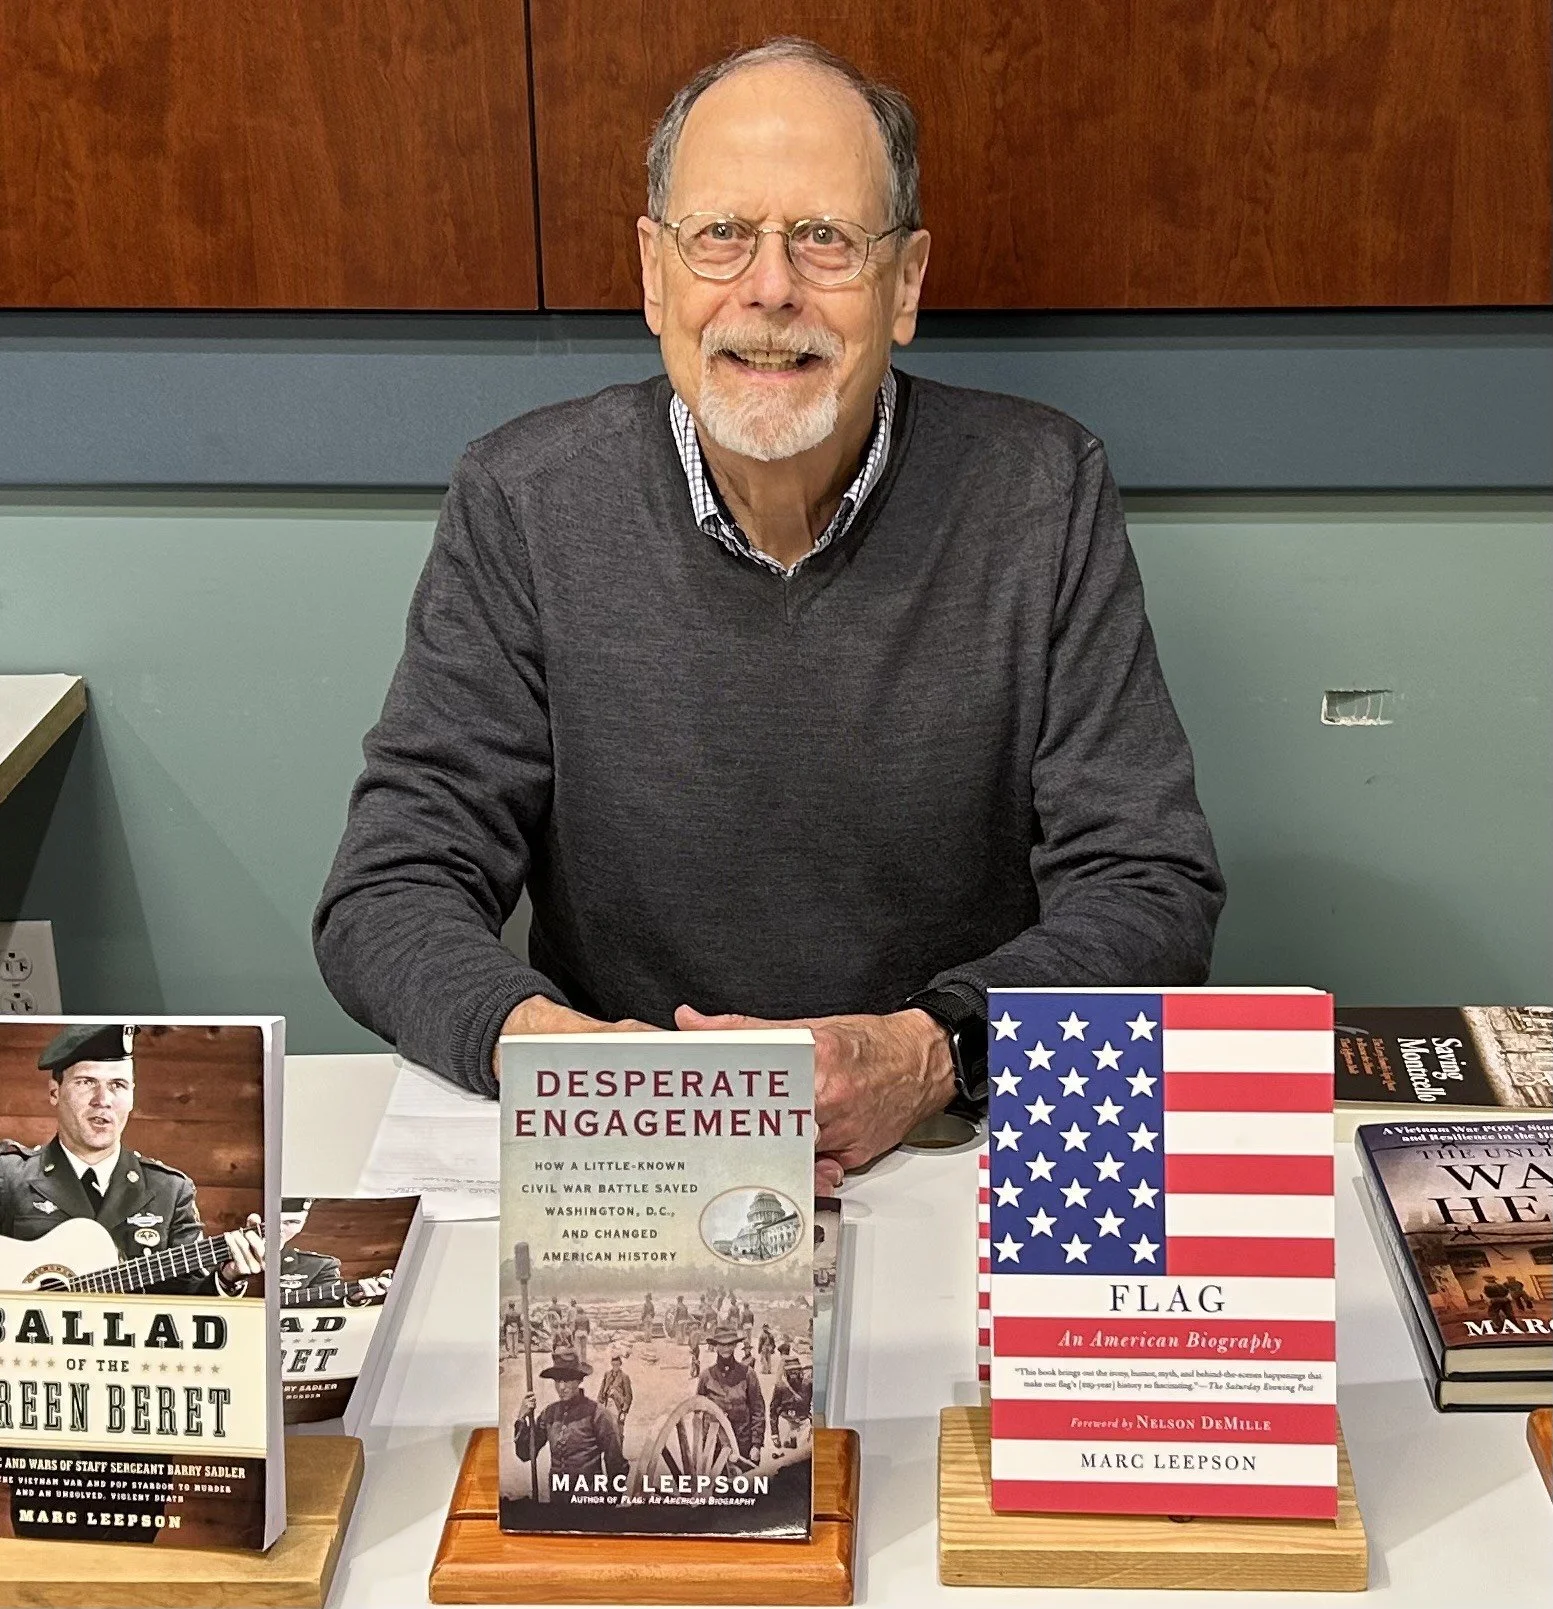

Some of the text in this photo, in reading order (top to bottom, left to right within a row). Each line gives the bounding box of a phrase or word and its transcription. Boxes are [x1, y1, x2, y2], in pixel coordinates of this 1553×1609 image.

[1431, 1037, 1466, 1081] Saving
[1397, 1037, 1447, 1102] Monticello
[536, 1070, 790, 1097] DESPERATE
[515, 1109, 812, 1137] ENGAGEMENT
[1383, 1127, 1393, 1136] A
[1393, 1125, 1450, 1134] Vietnam
[1452, 1125, 1480, 1133] War
[1401, 1133, 1426, 1142] and
[1428, 1132, 1496, 1141] Resilience
[1497, 1132, 1512, 1140] in
[1513, 1131, 1536, 1140] the
[1416, 1149, 1476, 1159] THE
[535, 1161, 686, 1171] HOW A LITTLE-KNOWN
[521, 1184, 698, 1193] CIVIL WAR BATTLE SAVED
[545, 1206, 676, 1217] WASHINGTON, D.C.,
[1428, 1195, 1553, 1225] HE
[562, 1229, 658, 1239] AND CHANGED
[542, 1251, 678, 1262] AMERICAN HISTORY
[1109, 1284, 1226, 1313] FLAG
[1463, 1318, 1553, 1337] MAR
[1058, 1329, 1283, 1355] An American Biography
[66, 1358, 129, 1373] OF THE
[1038, 1368, 1056, 1376] book
[1058, 1368, 1081, 1378] brings
[1180, 1370, 1194, 1378] and
[1307, 1372, 1322, 1380] that
[299, 1383, 338, 1392] SADLER
[1024, 1380, 1042, 1388] make
[1117, 1381, 1142, 1390] history
[1226, 1382, 1261, 1393] Saturday
[1263, 1383, 1295, 1393] Evening
[1297, 1383, 1314, 1392] Post
[106, 1383, 231, 1438] BERET
[1070, 1417, 1118, 1429] Foreword
[1121, 1418, 1134, 1431] by
[1136, 1415, 1195, 1430] NELSON
[5, 1457, 26, 1469] AND
[29, 1458, 58, 1471] WARS
[60, 1459, 73, 1472] OF
[75, 1460, 108, 1473] STAFF
[110, 1461, 165, 1475] SERGEANT
[167, 1464, 202, 1477] BARRY
[204, 1465, 246, 1479] SADLER
[1081, 1453, 1257, 1471] MARC LEEPSON
[18, 1476, 59, 1486] VIETNAM
[63, 1478, 83, 1487] WAR
[86, 1479, 106, 1488] AND
[110, 1480, 128, 1489] POP
[131, 1481, 174, 1491] STARDOM
[178, 1483, 190, 1492] TO
[194, 1483, 232, 1493] MURDER
[551, 1473, 770, 1494] MARC LEEPSON
[15, 1488, 35, 1497] AND
[38, 1489, 52, 1498] AN
[110, 1491, 150, 1502] VIOLENT
[154, 1494, 184, 1503] DEATH
[19, 1509, 182, 1529] MARC LEEPSON
